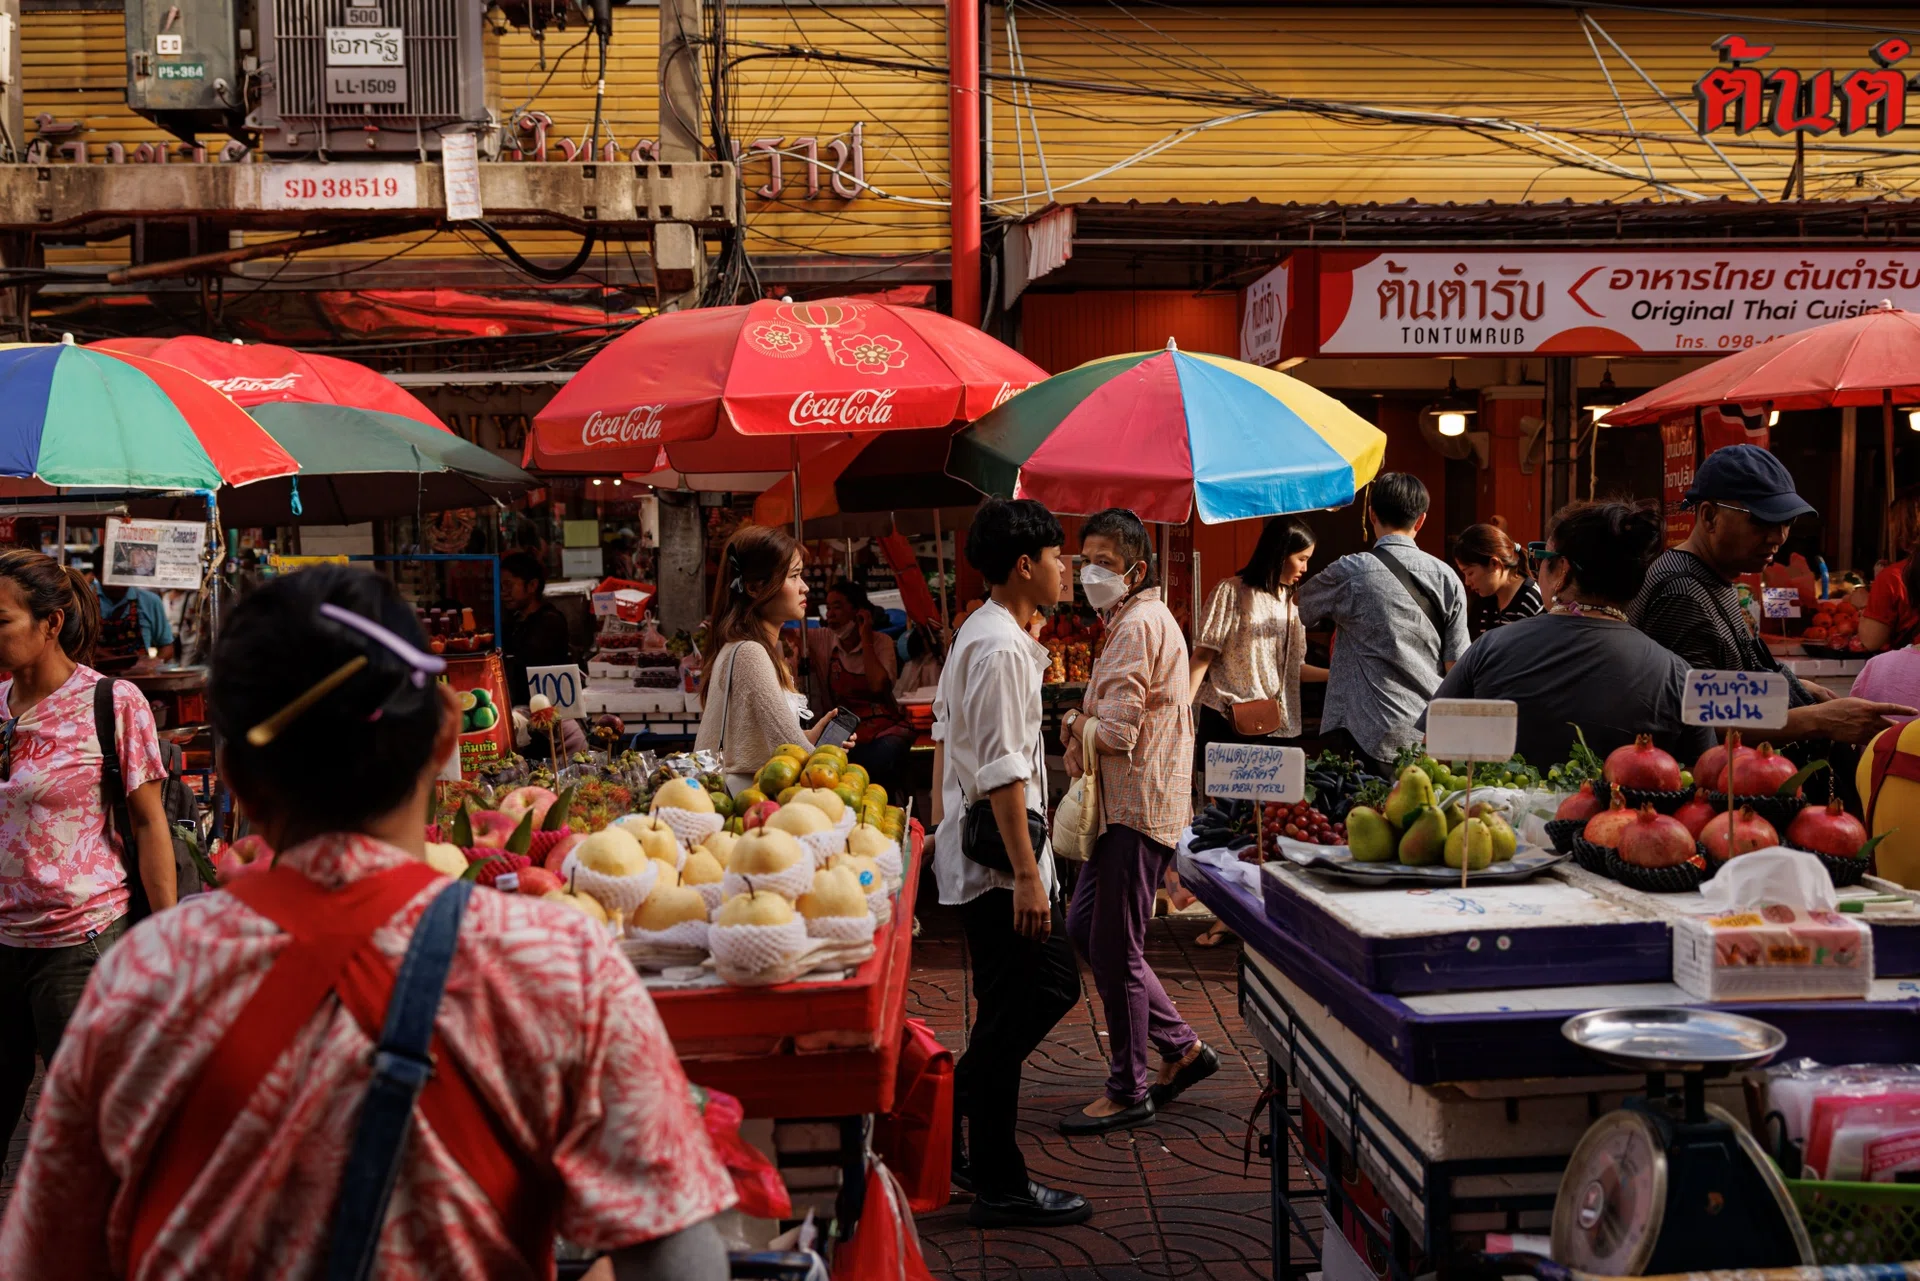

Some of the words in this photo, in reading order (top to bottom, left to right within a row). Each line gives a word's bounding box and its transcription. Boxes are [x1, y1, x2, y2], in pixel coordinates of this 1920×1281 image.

[350, 9, 378, 23] 500
[329, 31, 400, 62] เอกรัฐ
[1609, 261, 1776, 290] อาหารไทย
[1377, 260, 1546, 322] ต้นตำรับ
[1631, 299, 1735, 326] Original
[1744, 299, 1797, 320] Thai
[788, 387, 897, 427] Coca-Cola
[582, 403, 668, 446] Coca-Cola
[528, 672, 575, 707] 100
[1694, 673, 1768, 697] ทับทิม
[1699, 696, 1763, 722] สเปน
